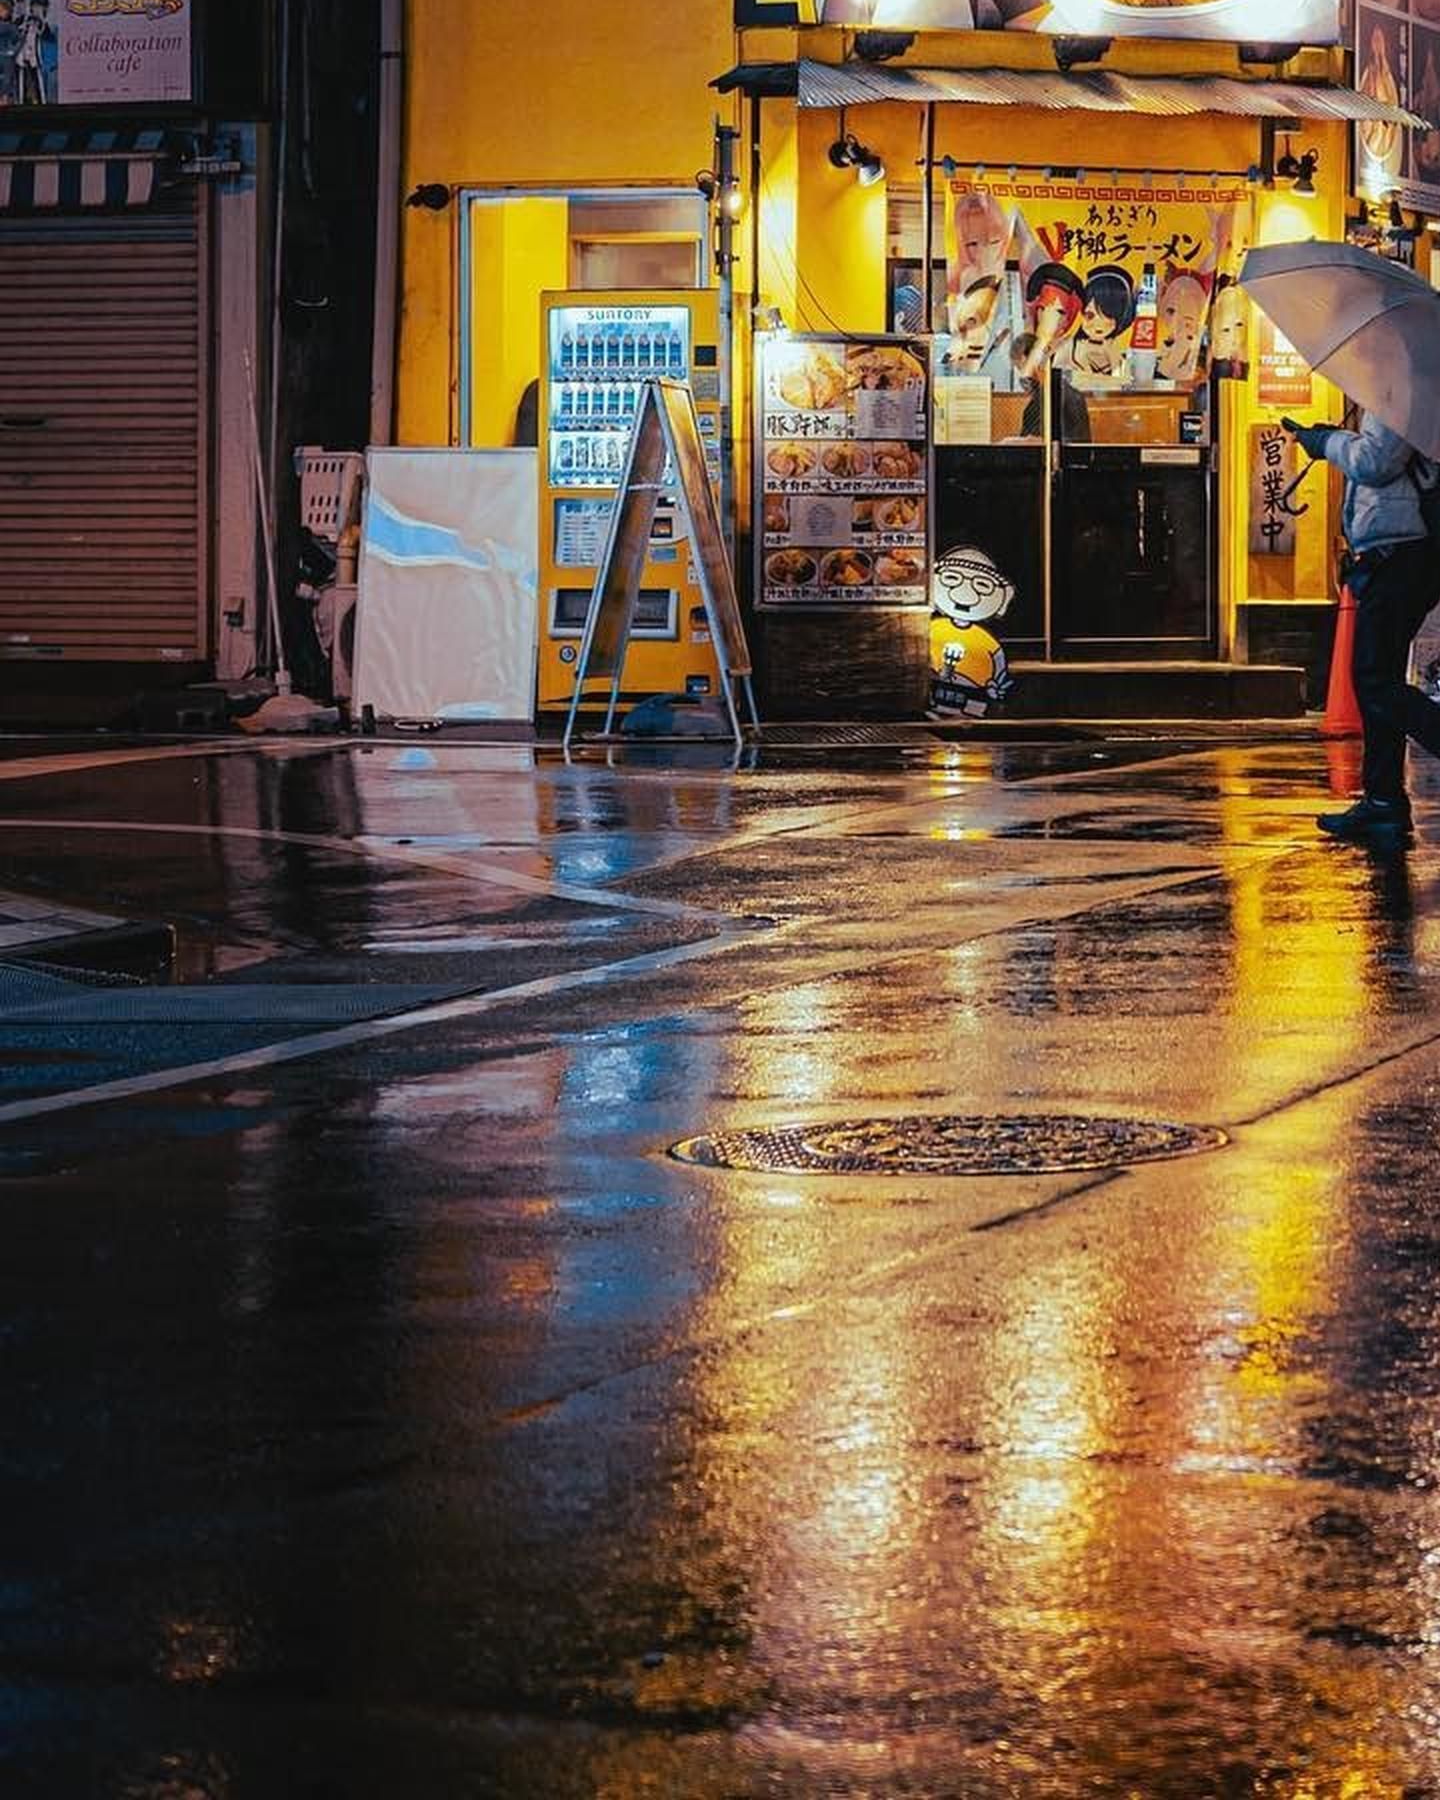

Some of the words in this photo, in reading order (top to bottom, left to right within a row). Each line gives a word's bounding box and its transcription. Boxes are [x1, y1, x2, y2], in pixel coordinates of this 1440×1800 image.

[66, 34, 183, 56] Collaboration
[1085, 203, 1160, 228] あおぎり
[1260, 428, 1287, 553] 営業中
